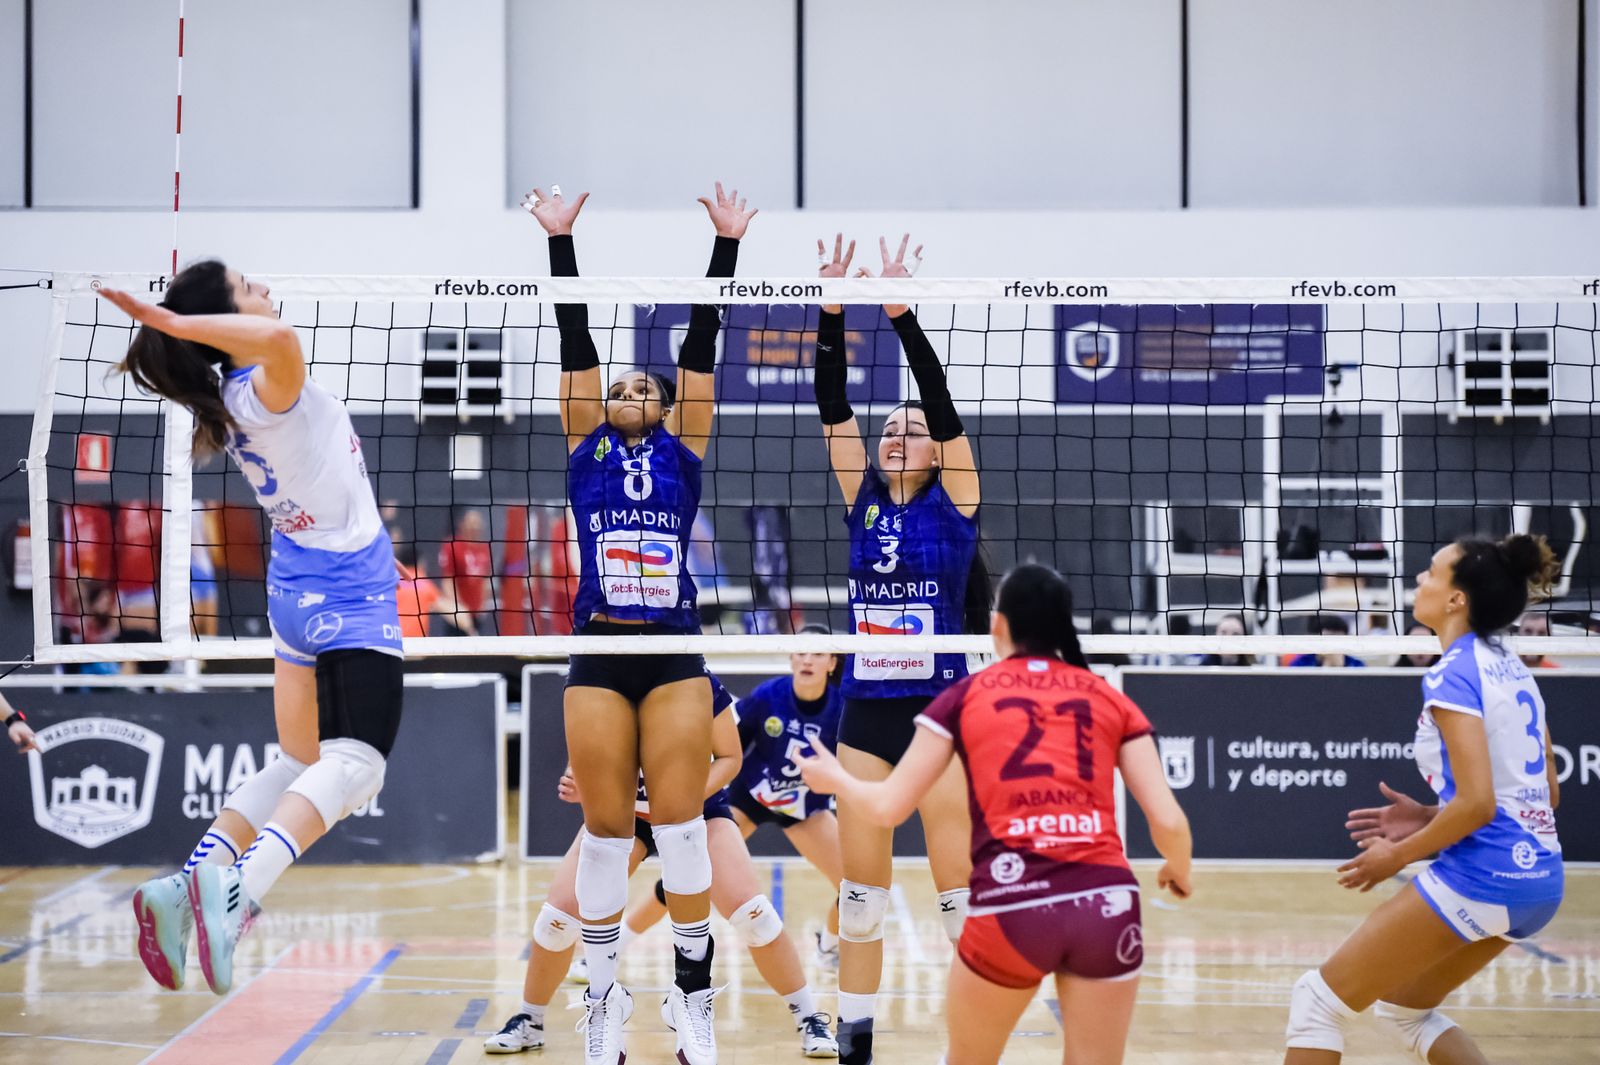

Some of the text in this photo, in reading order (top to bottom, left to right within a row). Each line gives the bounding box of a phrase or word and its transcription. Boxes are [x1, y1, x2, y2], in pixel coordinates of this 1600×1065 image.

[434, 278, 539, 296] rfevb.com
[719, 280, 823, 297] rfevb.com
[1004, 280, 1108, 297] rfevb.com
[1291, 280, 1396, 297] rfevb.com
[621, 458, 652, 501] 8
[872, 534, 900, 574] 3
[864, 581, 939, 599] MADRID
[993, 696, 1095, 783] 21
[1515, 690, 1546, 776] 3
[780, 737, 810, 778] 5
[1227, 735, 1320, 761] cultura,
[1228, 763, 1347, 792] y deporte
[1007, 810, 1102, 836] arenal
